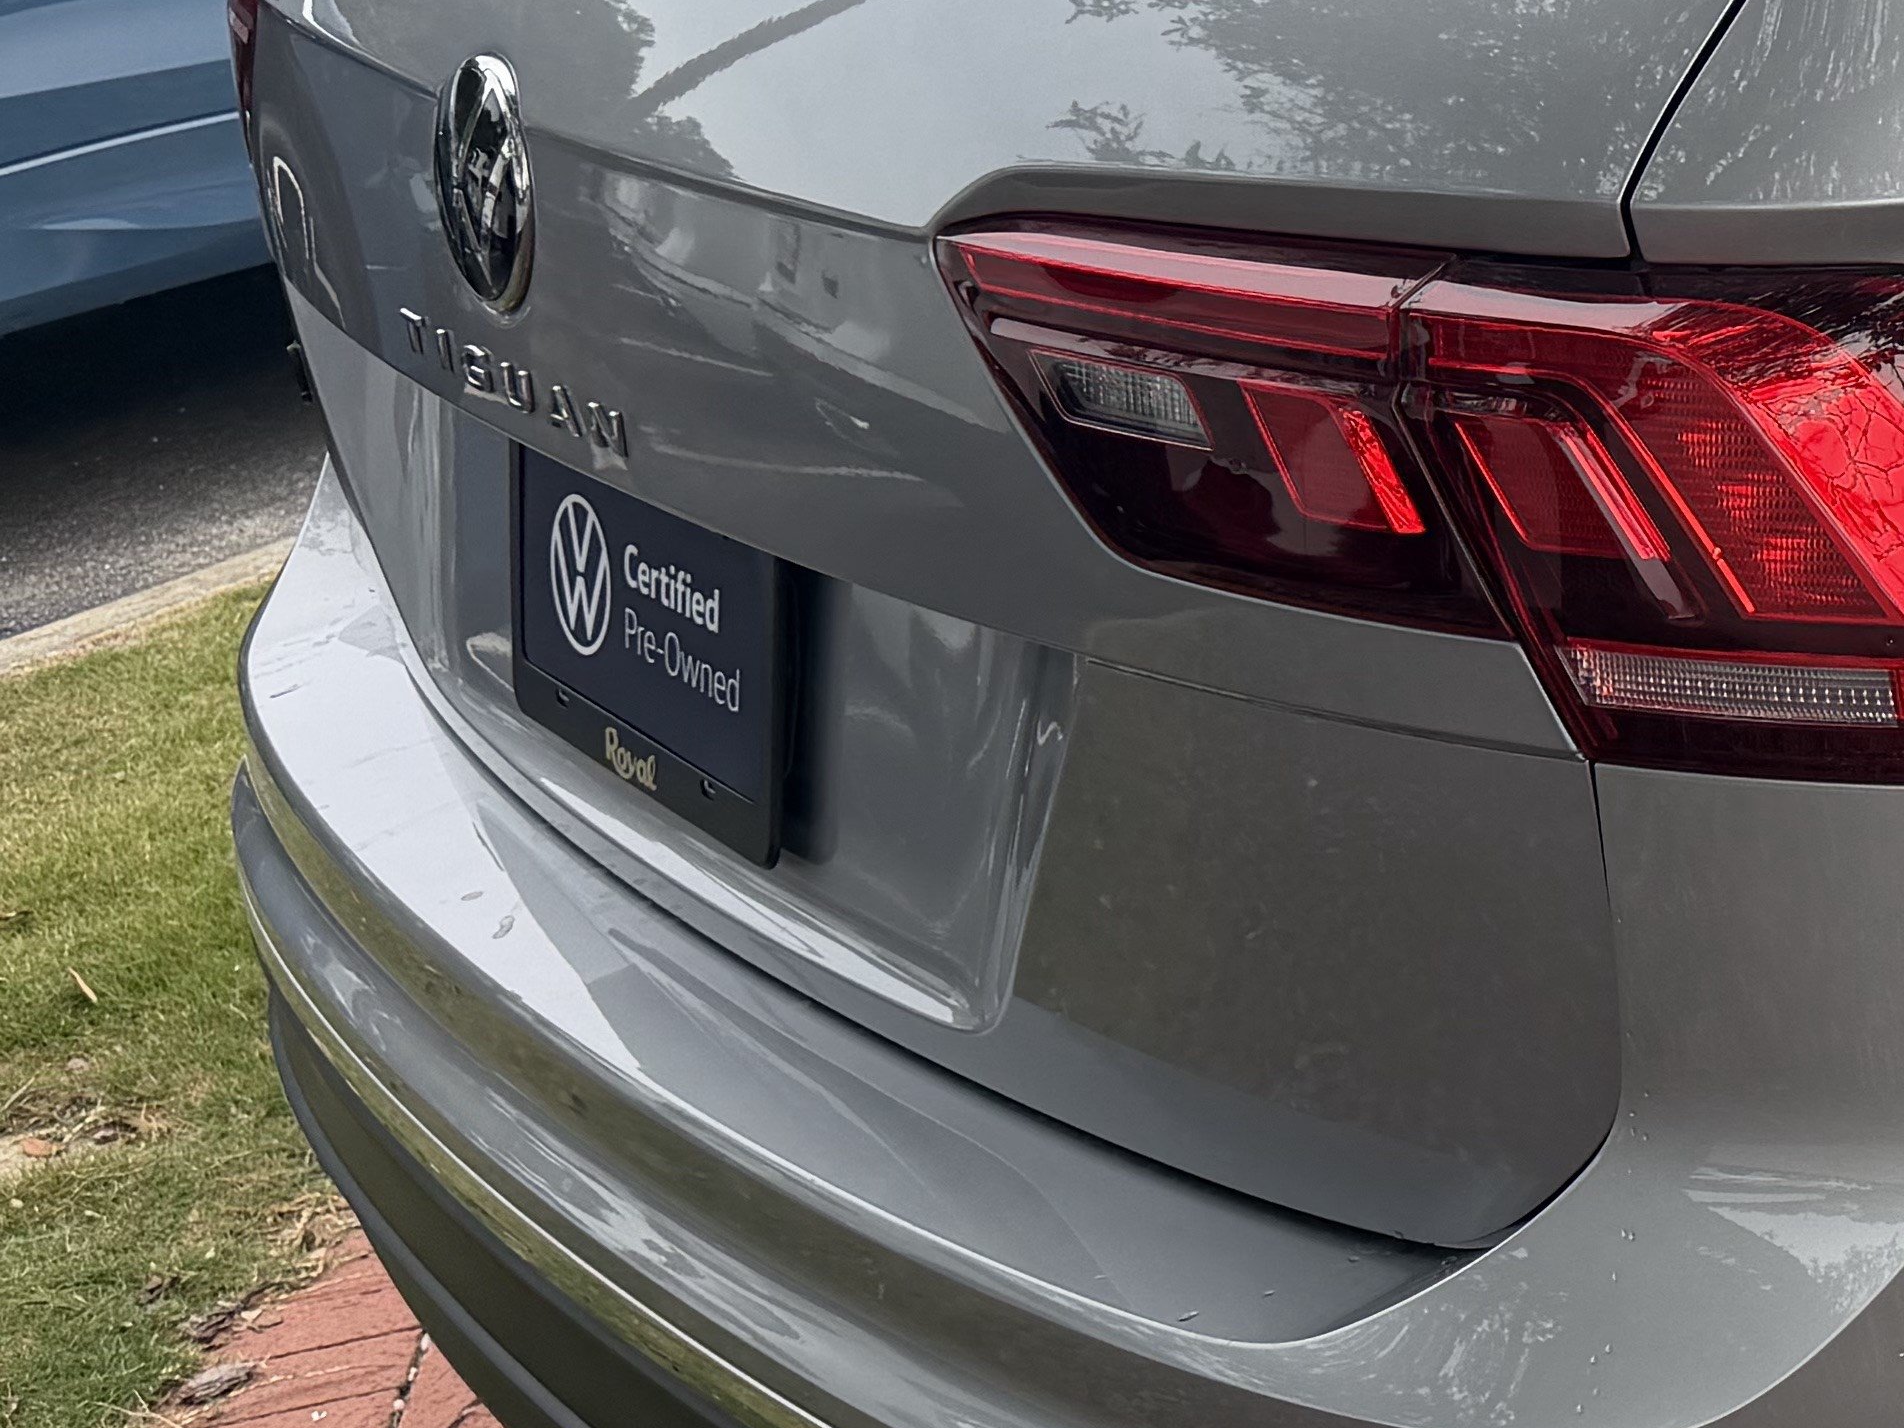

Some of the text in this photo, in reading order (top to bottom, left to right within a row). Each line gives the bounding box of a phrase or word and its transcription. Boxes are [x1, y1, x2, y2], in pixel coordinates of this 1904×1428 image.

[400, 306, 629, 459] TIGUAN
[624, 544, 720, 634] Certified
[624, 607, 740, 713] Pre-Owned
[605, 726, 657, 791] Royal
